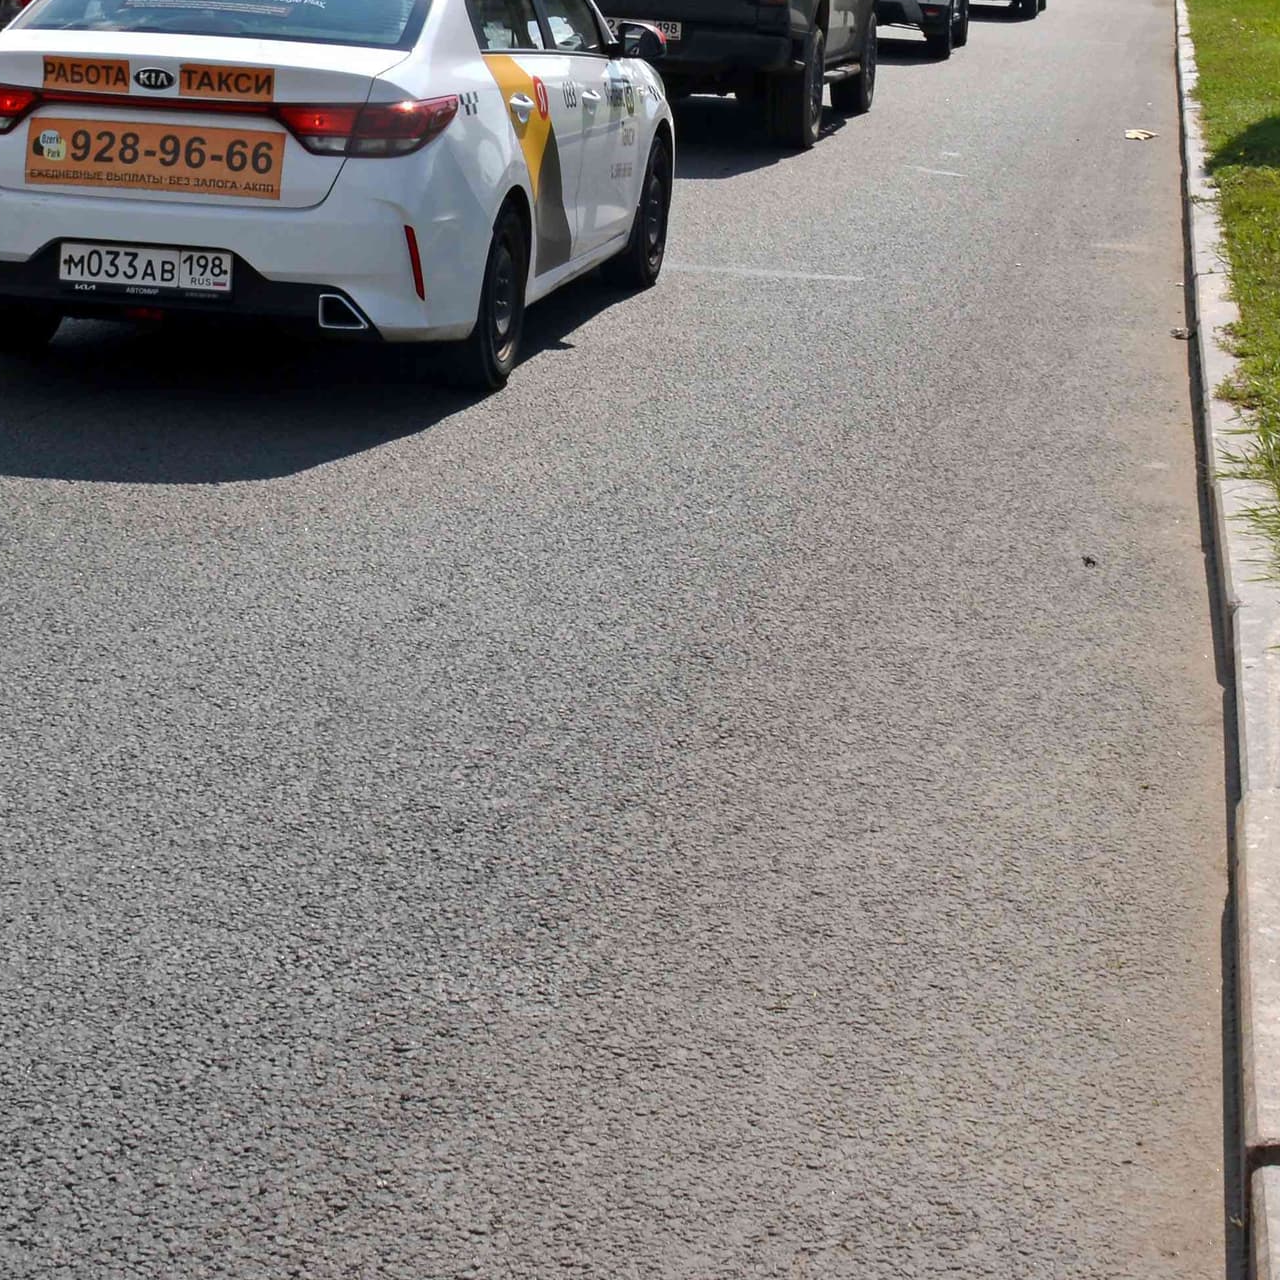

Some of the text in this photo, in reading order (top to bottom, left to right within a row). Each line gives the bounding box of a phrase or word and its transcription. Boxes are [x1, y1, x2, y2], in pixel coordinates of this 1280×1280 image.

[43, 61, 129, 87] РАБОТА
[138, 72, 169, 86] KIA
[181, 69, 271, 95] ТАКСИ
[70, 129, 273, 174] 928-96-66
[169, 175, 190, 186] БЕЗ
[193, 177, 237, 190] ЗАЛОГА
[243, 183, 274, 193] АКПП
[182, 254, 224, 278] 198
[190, 276, 212, 287] RUS
